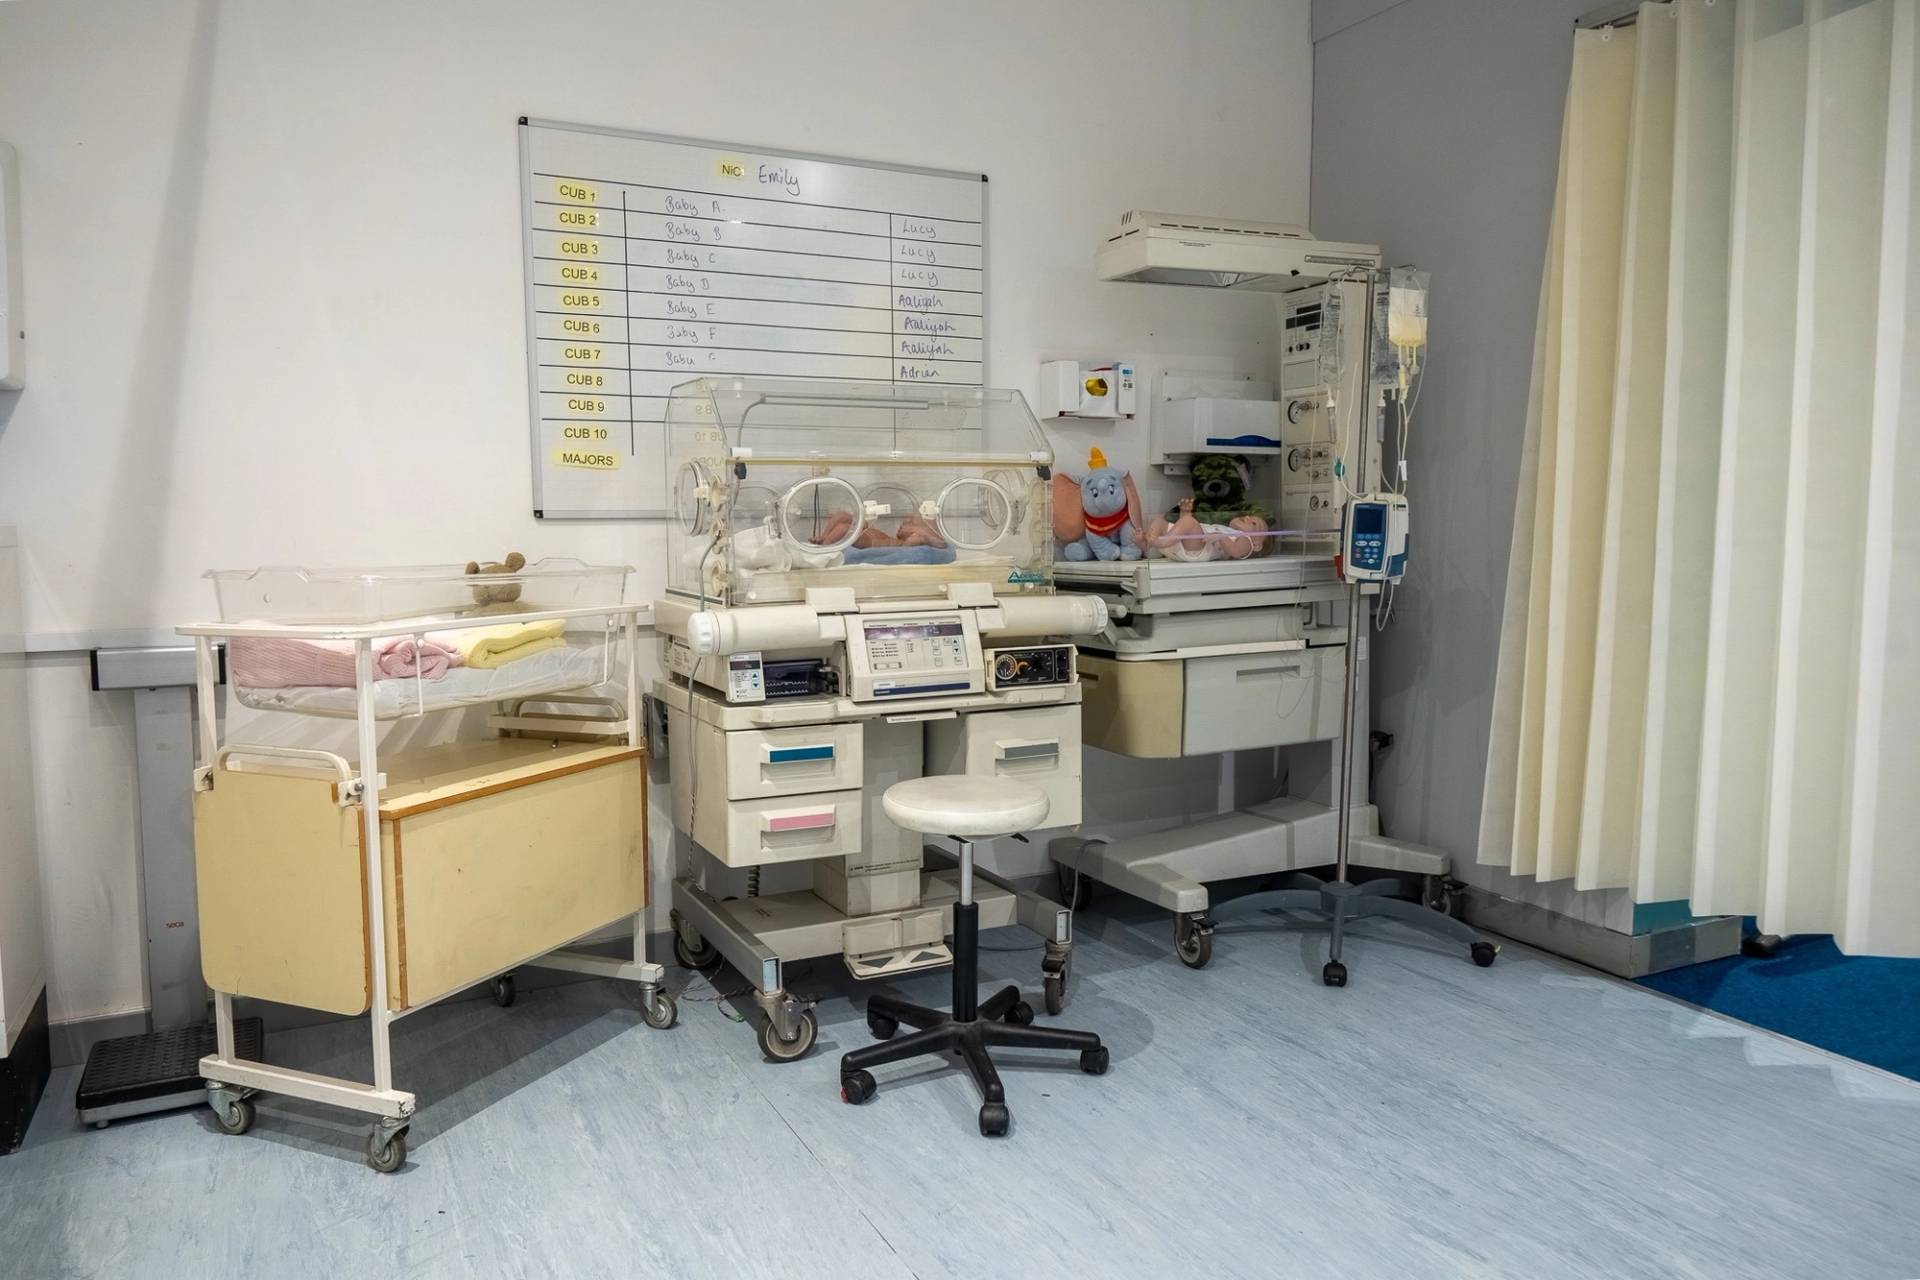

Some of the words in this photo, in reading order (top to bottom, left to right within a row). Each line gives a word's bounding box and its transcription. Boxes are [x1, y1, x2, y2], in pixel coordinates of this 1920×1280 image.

[759, 164, 801, 196] Emily
[559, 184, 586, 200] CUB
[590, 192, 597, 201] 1
[665, 195, 699, 216] Baby
[559, 212, 586, 225] CUB
[588, 216, 597, 226] 2
[665, 221, 700, 241] Baby
[713, 227, 721, 240] B
[903, 218, 937, 239] Lucy
[561, 242, 588, 254] CUB
[591, 245, 599, 255] 3
[901, 245, 937, 264] Lucy
[667, 248, 700, 267] Baby
[561, 267, 588, 280] CUB
[590, 270, 599, 280] 4
[901, 269, 939, 288] Lucy
[666, 274, 696, 293] Baby
[701, 278, 710, 290] D
[563, 295, 590, 306] CUB
[592, 296, 600, 306] 5
[667, 300, 697, 318] Baby
[706, 303, 717, 315] E
[563, 319, 590, 332] CUB
[593, 323, 600, 334] 6
[709, 327, 717, 339] F
[564, 348, 591, 360] CUB
[594, 350, 601, 361] 7
[566, 373, 593, 386] CUB
[596, 375, 603, 386] 8
[568, 399, 594, 412] CUB
[597, 402, 605, 412] 9
[564, 427, 591, 439] CUB
[594, 429, 608, 440] 10
[562, 452, 614, 466] MAJORS
